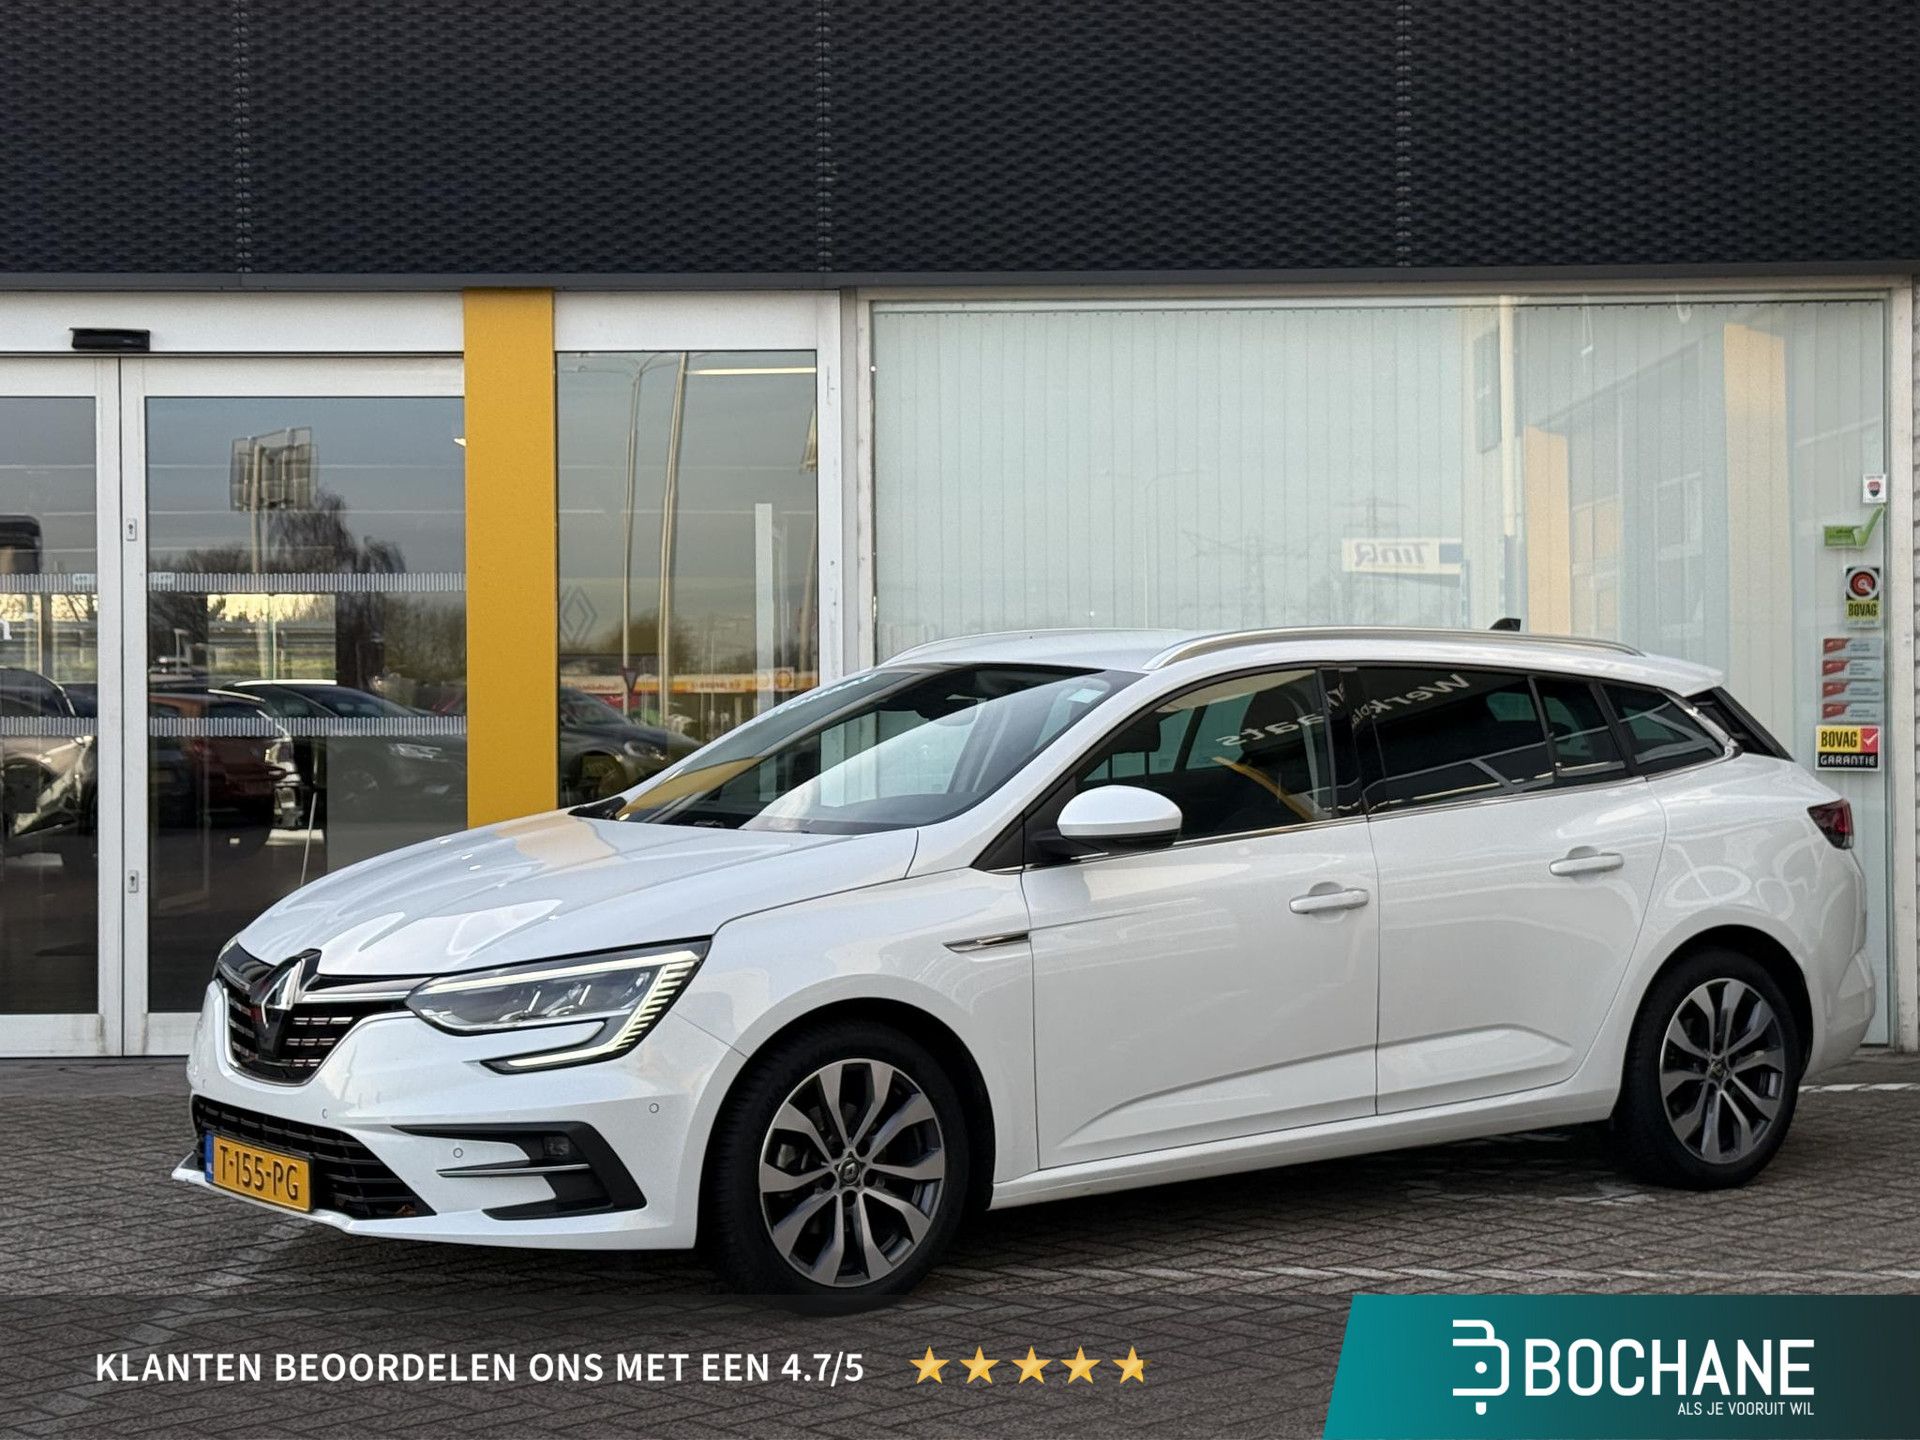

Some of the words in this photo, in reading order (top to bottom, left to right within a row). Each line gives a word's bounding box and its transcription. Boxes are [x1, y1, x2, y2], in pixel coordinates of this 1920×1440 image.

[1848, 602, 1877, 617] BOVAG
[1820, 730, 1858, 748] BOVAG
[1820, 755, 1876, 766] GARANTIE
[220, 1145, 299, 1201] T-155-PG
